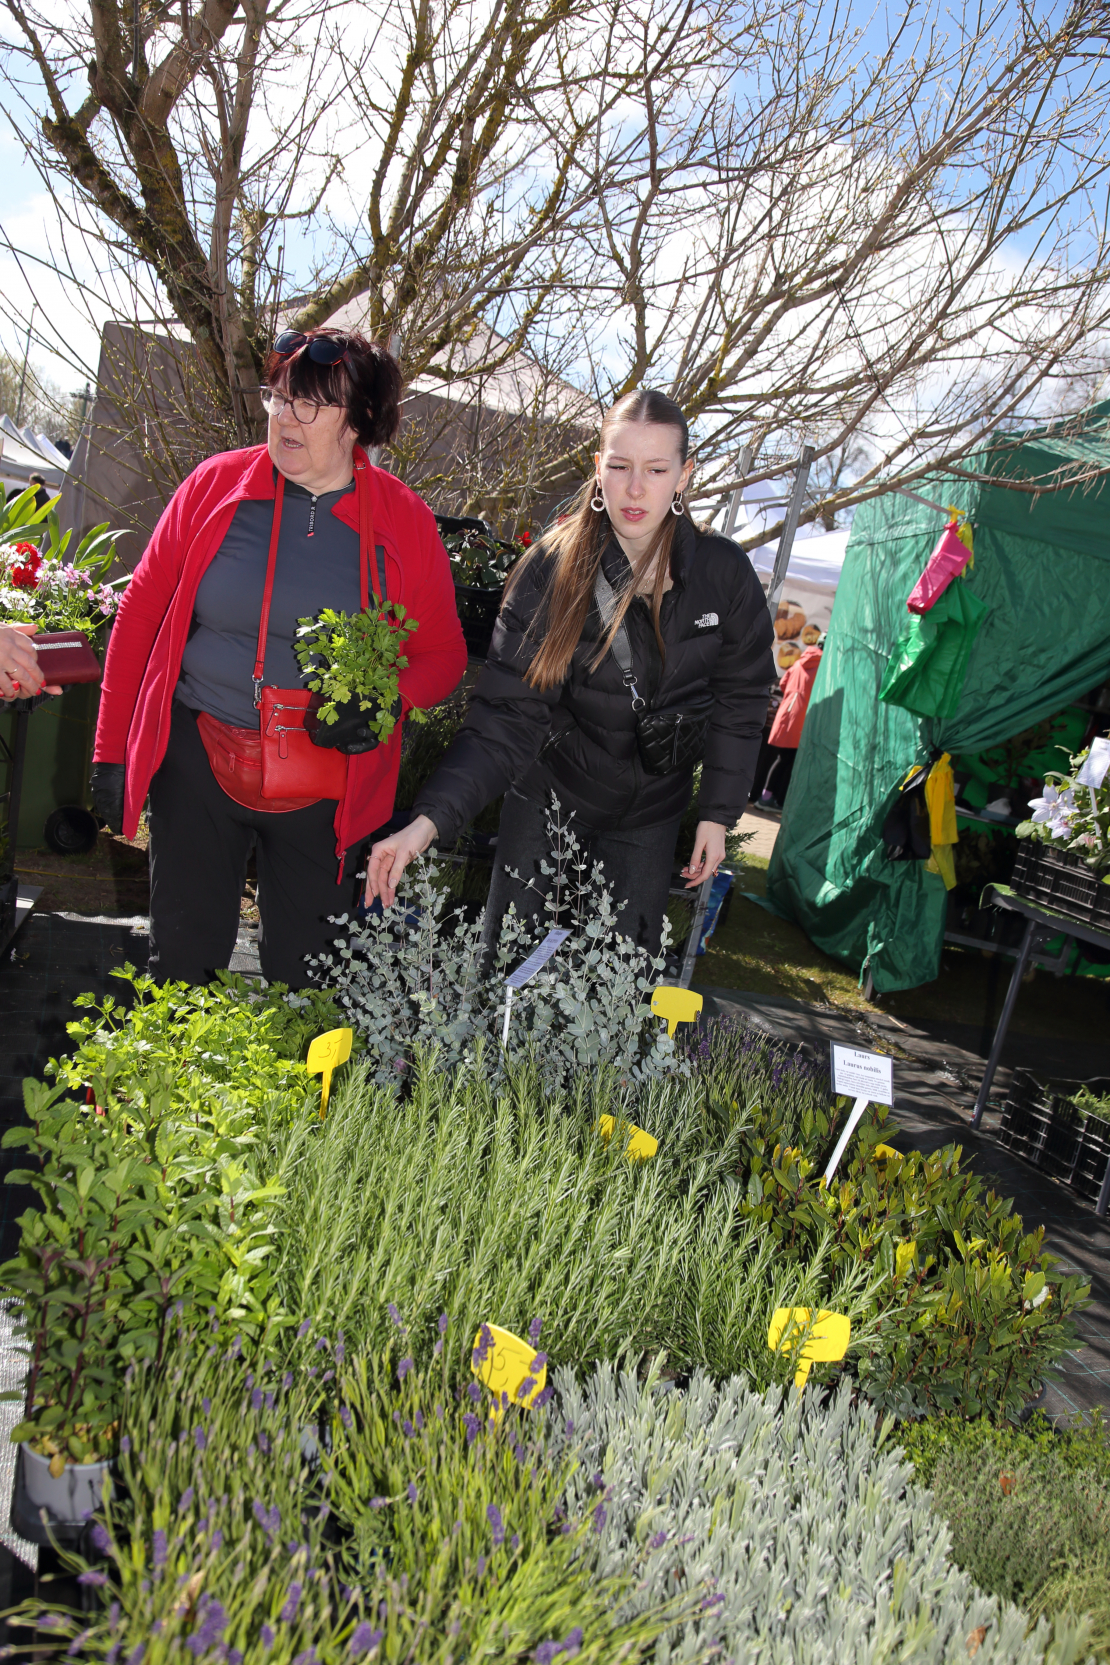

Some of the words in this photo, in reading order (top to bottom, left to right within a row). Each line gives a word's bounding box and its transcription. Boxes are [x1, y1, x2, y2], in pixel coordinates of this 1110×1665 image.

[854, 1051, 871, 1060] Laurs
[843, 1059, 863, 1070] Laurus
[863, 1065, 882, 1074] nobilis
